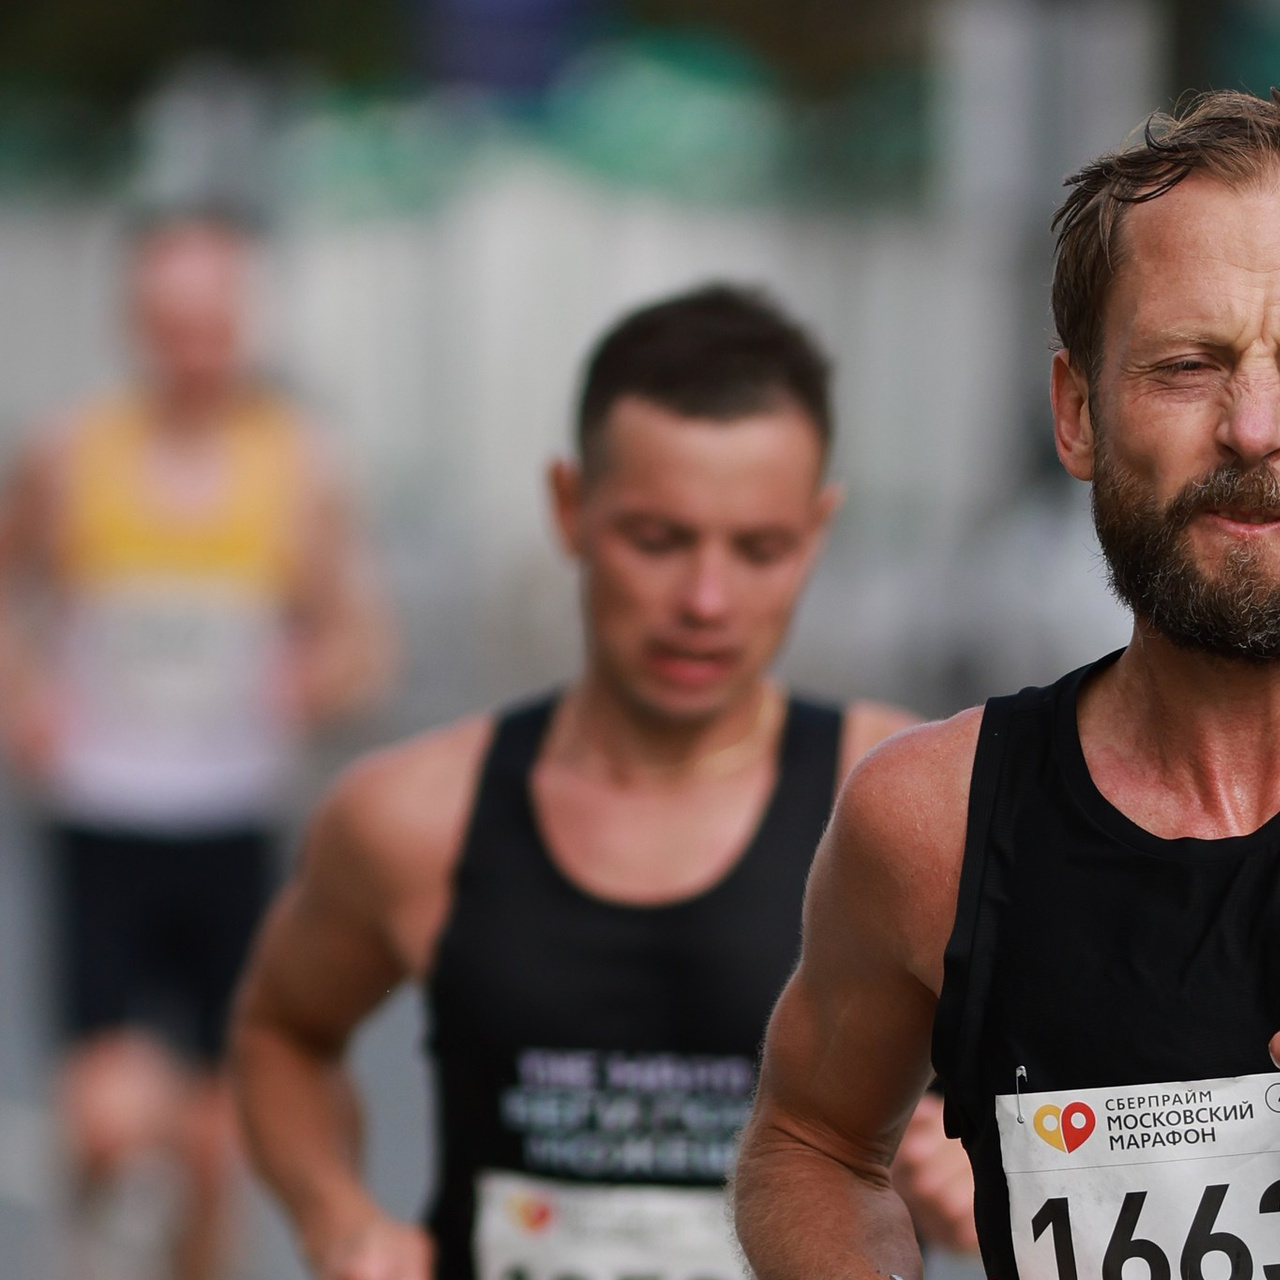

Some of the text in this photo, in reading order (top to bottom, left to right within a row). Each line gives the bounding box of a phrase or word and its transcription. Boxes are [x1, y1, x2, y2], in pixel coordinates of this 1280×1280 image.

[1105, 1089, 1212, 1111] СБЕРПРАЙМ
[1107, 1101, 1254, 1131] МОСКОВСКИЙ
[1109, 1127, 1216, 1151] МАРАФОН
